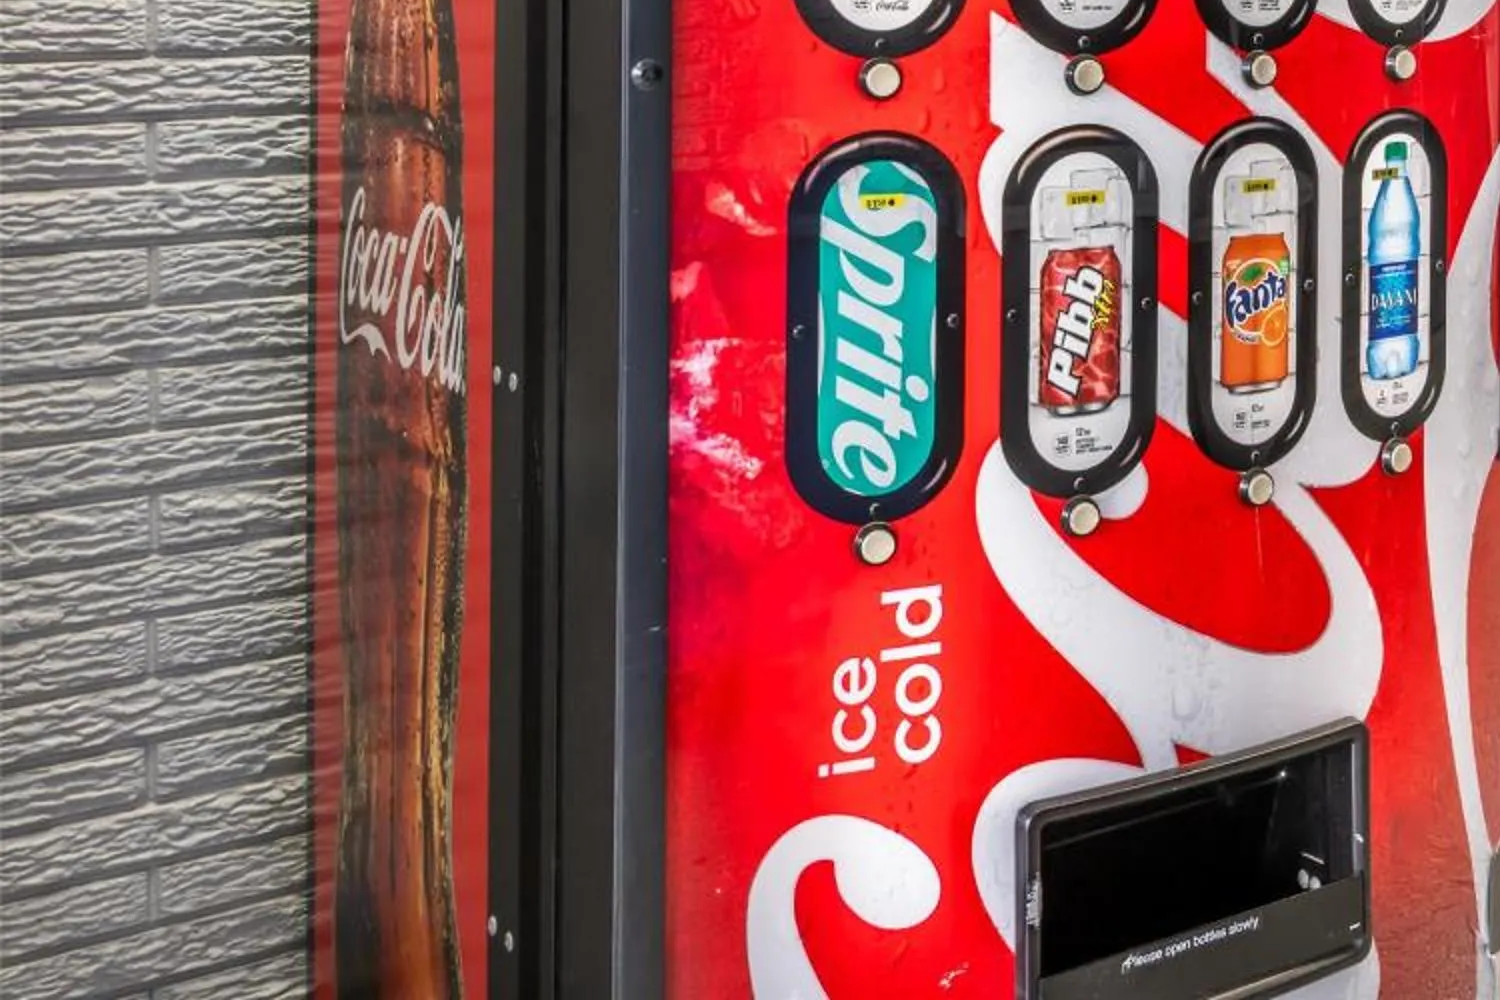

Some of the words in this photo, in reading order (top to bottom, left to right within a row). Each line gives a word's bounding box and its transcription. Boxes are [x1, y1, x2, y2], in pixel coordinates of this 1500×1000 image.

[340, 187, 466, 397] Coca-Cola
[820, 160, 938, 489] Sprite
[1048, 266, 1105, 397] Pibb
[818, 656, 877, 779] ice
[881, 584, 943, 764] cold
[1164, 939, 1191, 958] open
[1193, 926, 1227, 947] bottles
[1227, 915, 1260, 935] slowly
